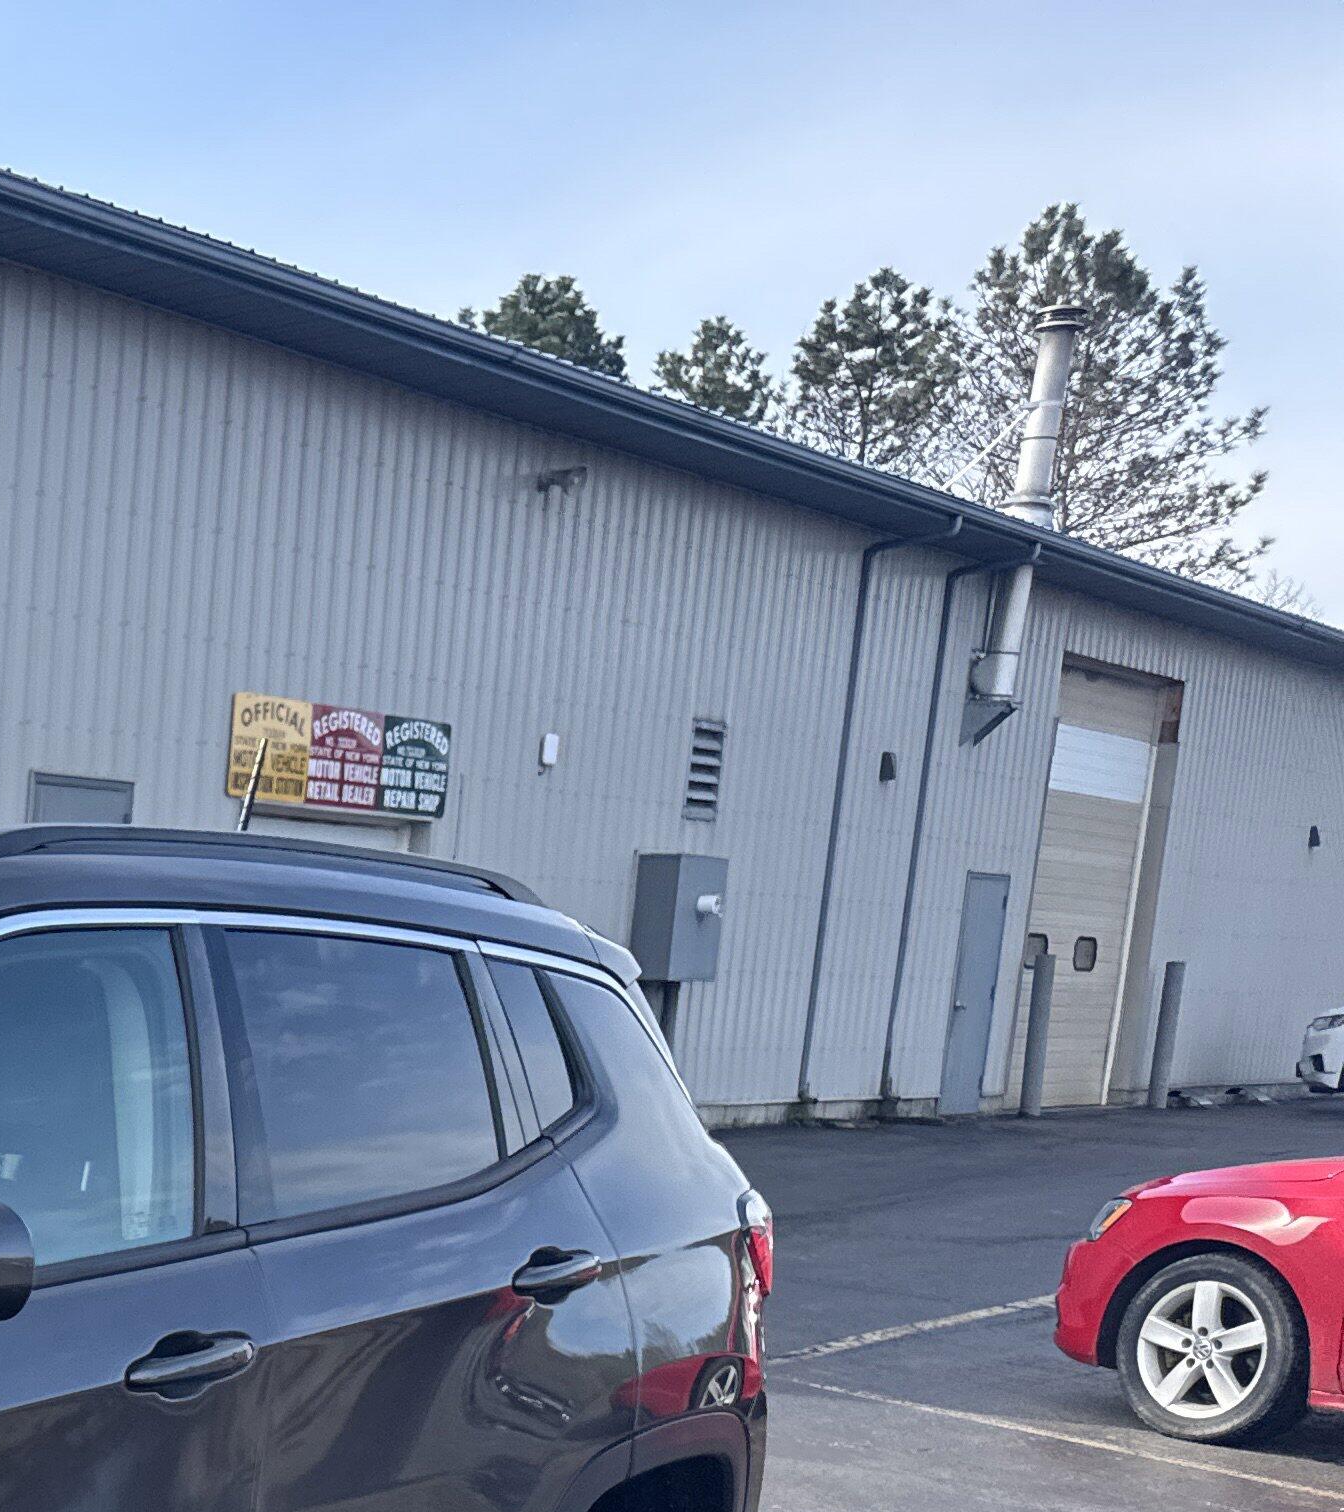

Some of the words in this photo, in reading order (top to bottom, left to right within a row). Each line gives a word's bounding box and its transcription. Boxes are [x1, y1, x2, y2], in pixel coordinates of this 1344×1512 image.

[241, 701, 305, 737] OFFICIAL
[313, 710, 381, 746] REGISTERED
[385, 721, 448, 756] REGISTERED
[309, 745, 332, 758] STATE
[333, 749, 344, 759] OF
[345, 750, 360, 761] NEW
[382, 755, 404, 768] STATE
[405, 758, 415, 768] OF
[416, 760, 430, 770] NEW
[308, 758, 341, 780] MOTOR
[343, 763, 378, 785] VEHICLE
[380, 767, 412, 787] MOTOR
[414, 771, 447, 793] VEHICLE
[306, 780, 339, 802] RETAIL
[341, 784, 376, 806] DEALER
[384, 789, 416, 809] REPAIR
[418, 792, 441, 812] SHOP
